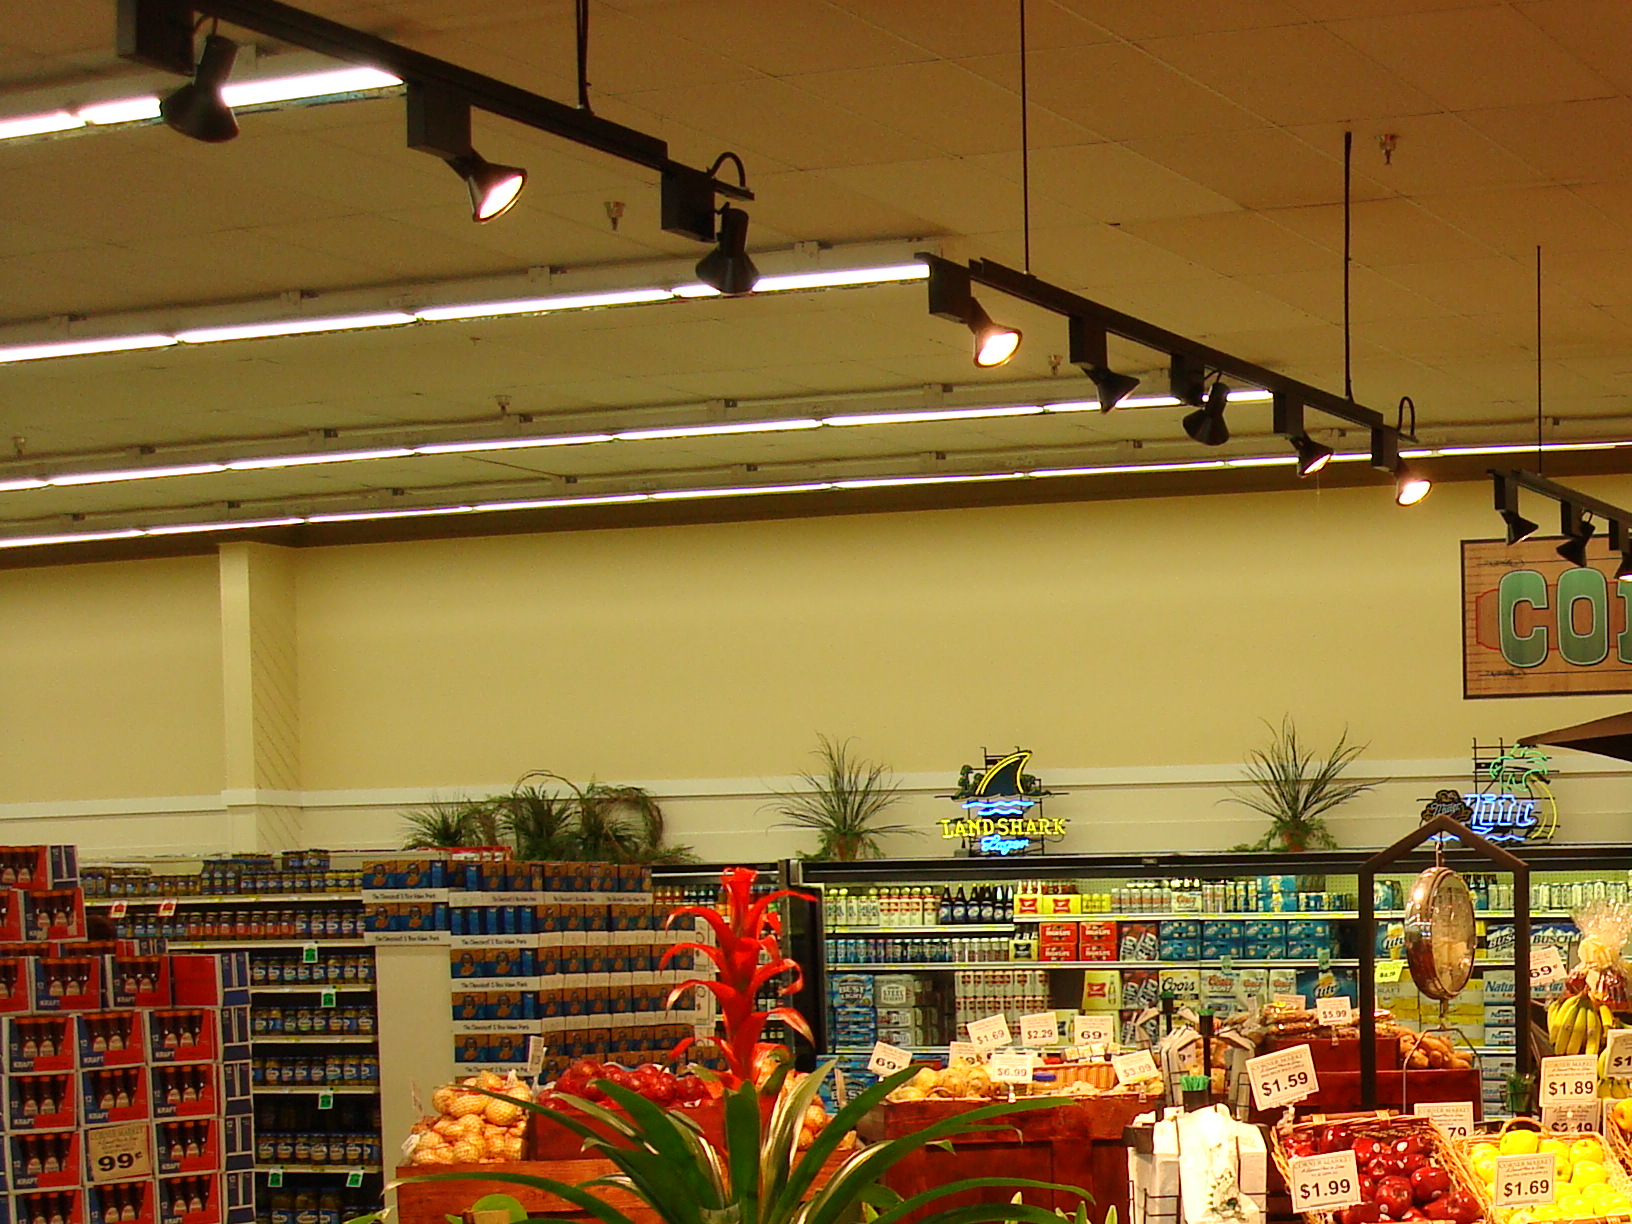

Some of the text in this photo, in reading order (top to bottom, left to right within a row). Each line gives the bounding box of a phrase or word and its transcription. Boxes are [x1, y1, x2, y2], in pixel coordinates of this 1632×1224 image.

[1463, 793, 1539, 835] Lite
[1488, 933, 1515, 949] BUS
[1162, 976, 1195, 992] Coors
[1485, 981, 1515, 993] Natur
[1322, 1010, 1347, 1019] $5.99
[976, 1029, 1005, 1044] $1.69
[1026, 1030, 1053, 1040] $2.29
[997, 1067, 1027, 1078] $6.99
[1122, 1063, 1152, 1077] $3.09
[1261, 1071, 1308, 1097] $1.59
[1548, 1080, 1594, 1096] $1.89
[98, 1152, 143, 1172] 99¢
[1300, 1178, 1350, 1200] $1.99
[1503, 1179, 1549, 1198] $1.69
